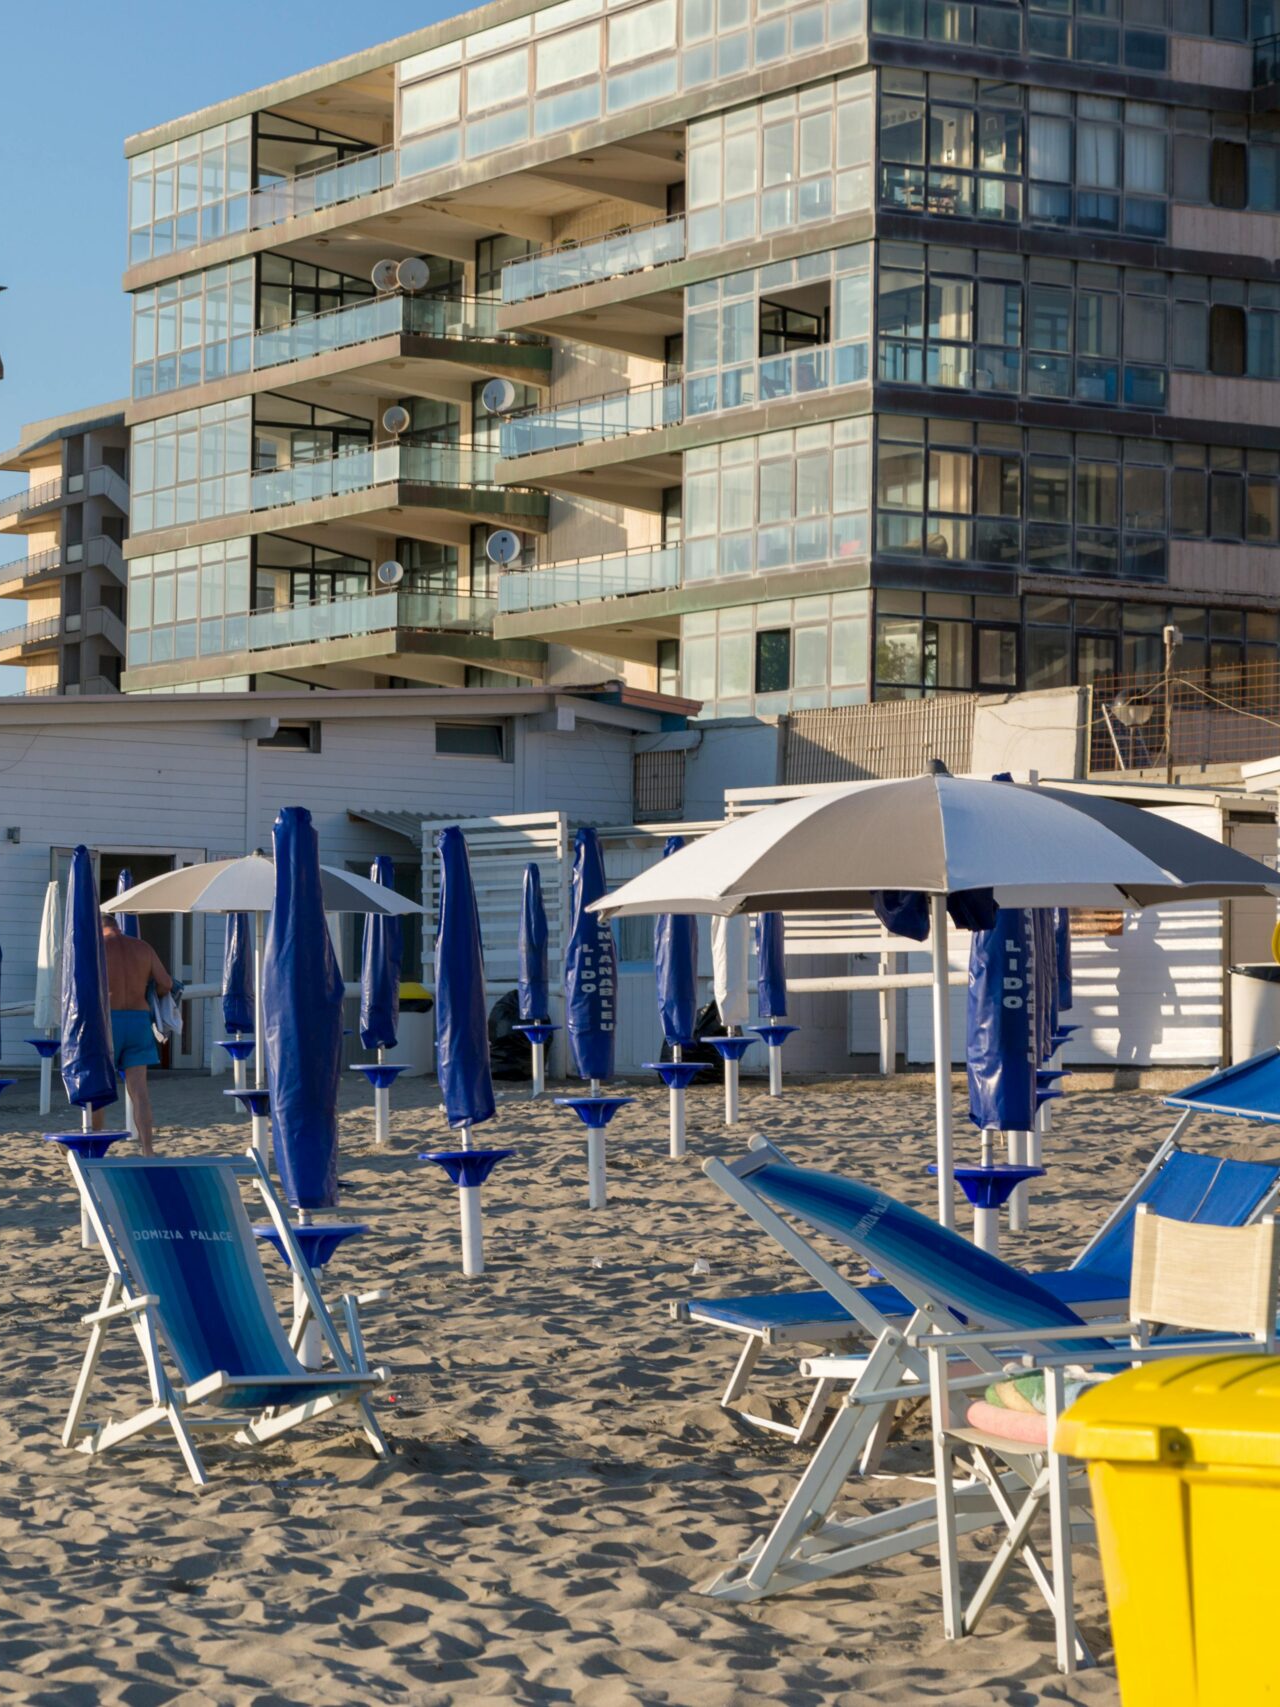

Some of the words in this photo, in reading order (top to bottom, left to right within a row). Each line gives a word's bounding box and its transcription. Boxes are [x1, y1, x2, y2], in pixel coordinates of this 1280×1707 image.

[581, 943, 597, 993] LIDO
[597, 918, 613, 1031] ONTANABLEU
[1003, 939, 1023, 1009] LIDO
[133, 1229, 184, 1241] DOMIZIA
[189, 1229, 233, 1242] PALACE
